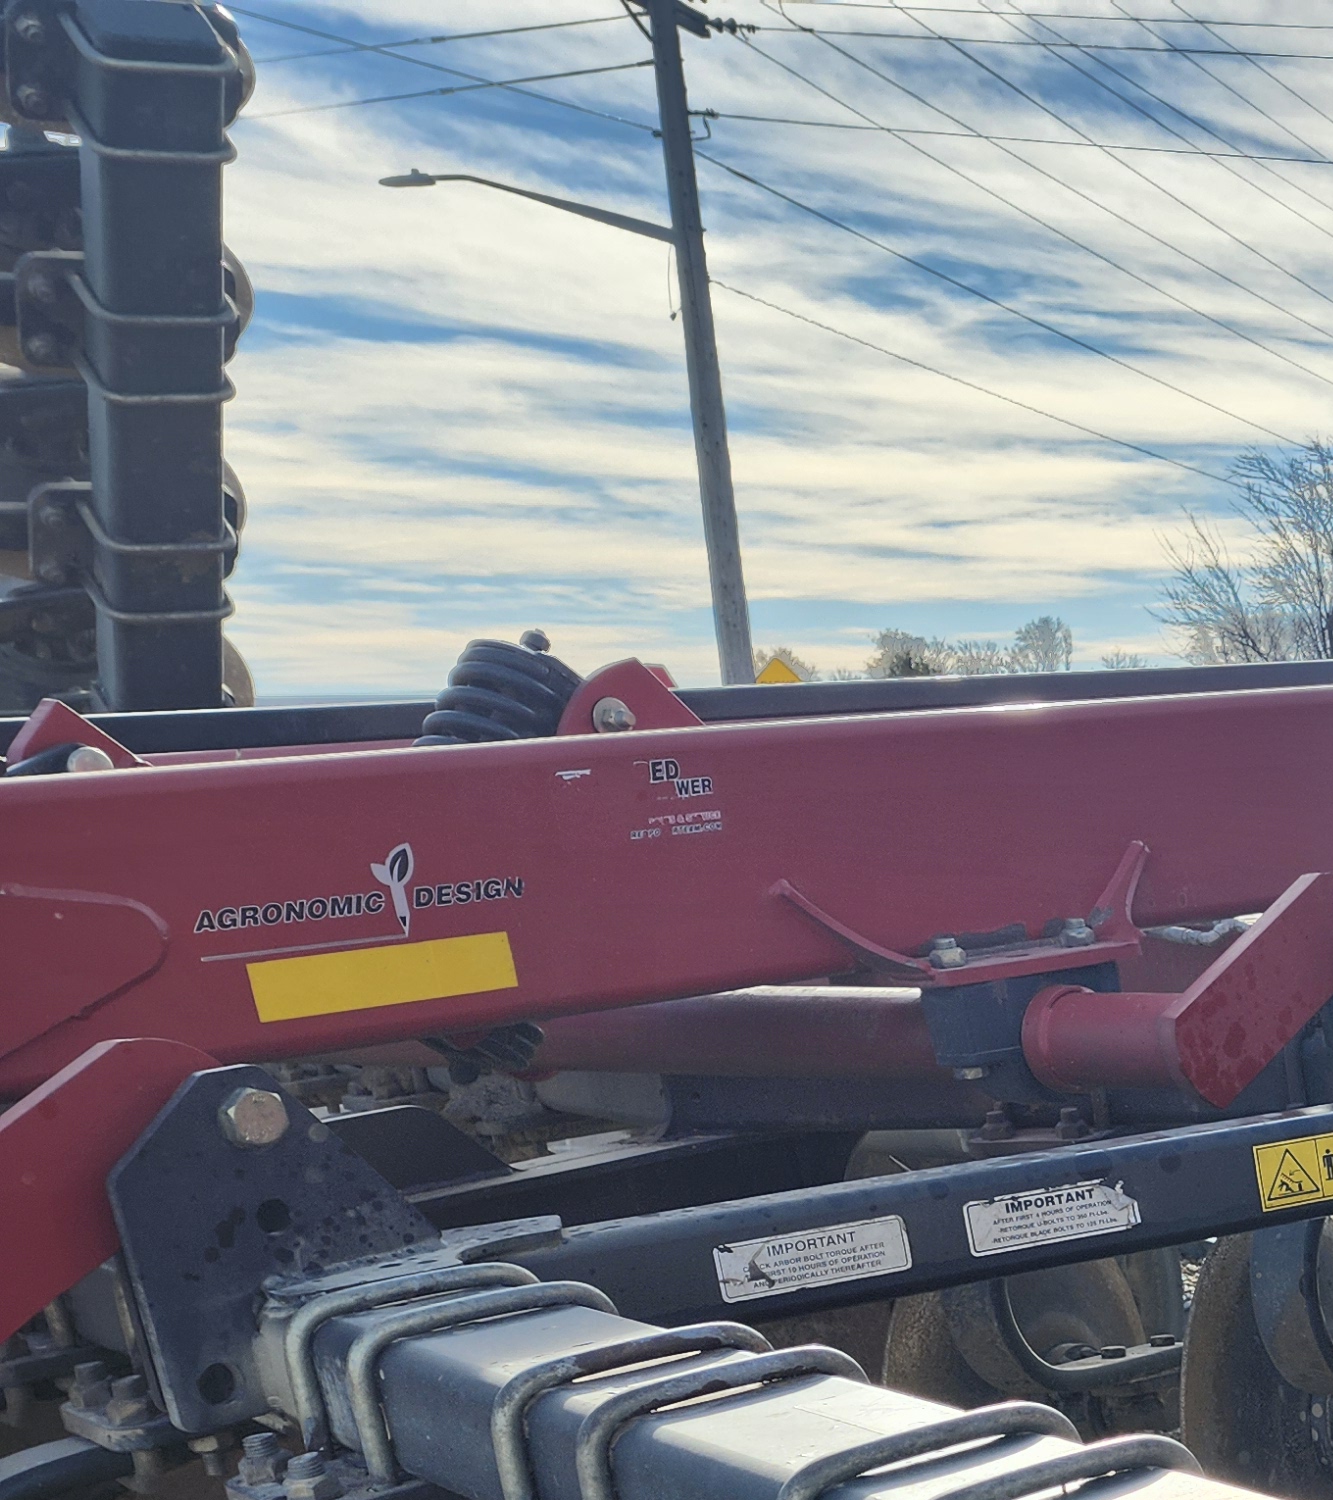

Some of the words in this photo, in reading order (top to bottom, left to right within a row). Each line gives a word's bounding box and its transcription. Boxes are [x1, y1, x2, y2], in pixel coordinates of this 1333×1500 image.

[649, 758, 680, 784] ED
[194, 892, 385, 933] AGRONOMIC
[413, 876, 525, 909] DESIGN
[993, 1217, 1014, 1226] AFTER
[1016, 1213, 1034, 1222] FIRST
[1041, 1208, 1064, 1217] HOURS
[1076, 1199, 1112, 1211] OPERATION
[1005, 1188, 1095, 1213] IMPORTANT
[1030, 1228, 1052, 1238] BLADE
[1053, 1224, 1075, 1234] BOLTS
[1037, 1217, 1065, 1227] U-BOLTS
[766, 1231, 856, 1257] IMPORTANT
[743, 1261, 771, 1273] CCK
[773, 1257, 802, 1268] ARBOR
[804, 1253, 824, 1262] BOLT
[825, 1247, 859, 1258] TORQUE
[860, 1241, 886, 1252] AFTER
[788, 1266, 798, 1274] 10
[799, 1262, 828, 1272] HOURS
[828, 1258, 840, 1267] OF
[841, 1250, 887, 1264] OPERATION
[831, 1259, 883, 1275] THEREAFTER
